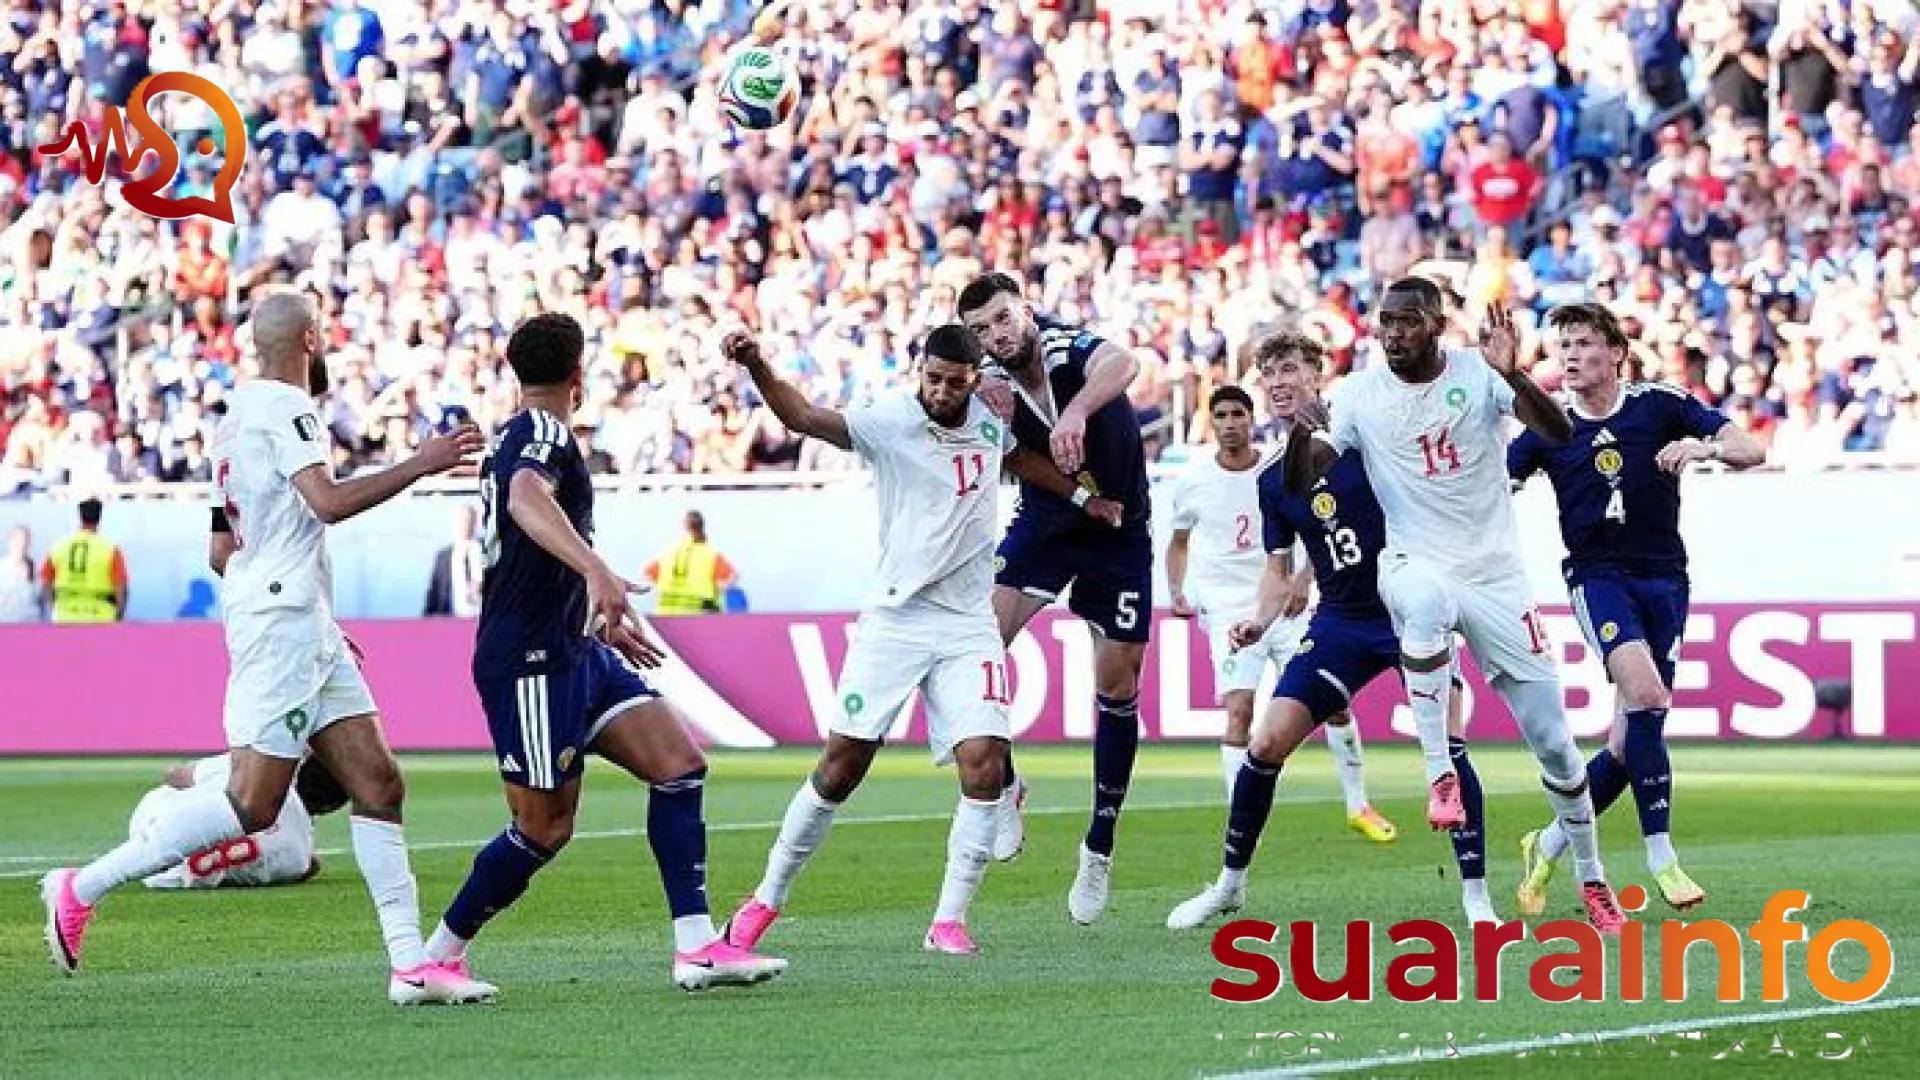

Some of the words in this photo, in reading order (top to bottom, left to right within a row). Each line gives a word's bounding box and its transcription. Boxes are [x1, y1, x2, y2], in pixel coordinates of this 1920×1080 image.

[1416, 429, 1461, 476] 14
[952, 453, 984, 497] 11
[1605, 489, 1626, 525] 4
[1236, 514, 1252, 549] 2
[1325, 527, 1363, 571] 13
[1116, 591, 1139, 630] 5
[1541, 612, 1916, 738] BEST
